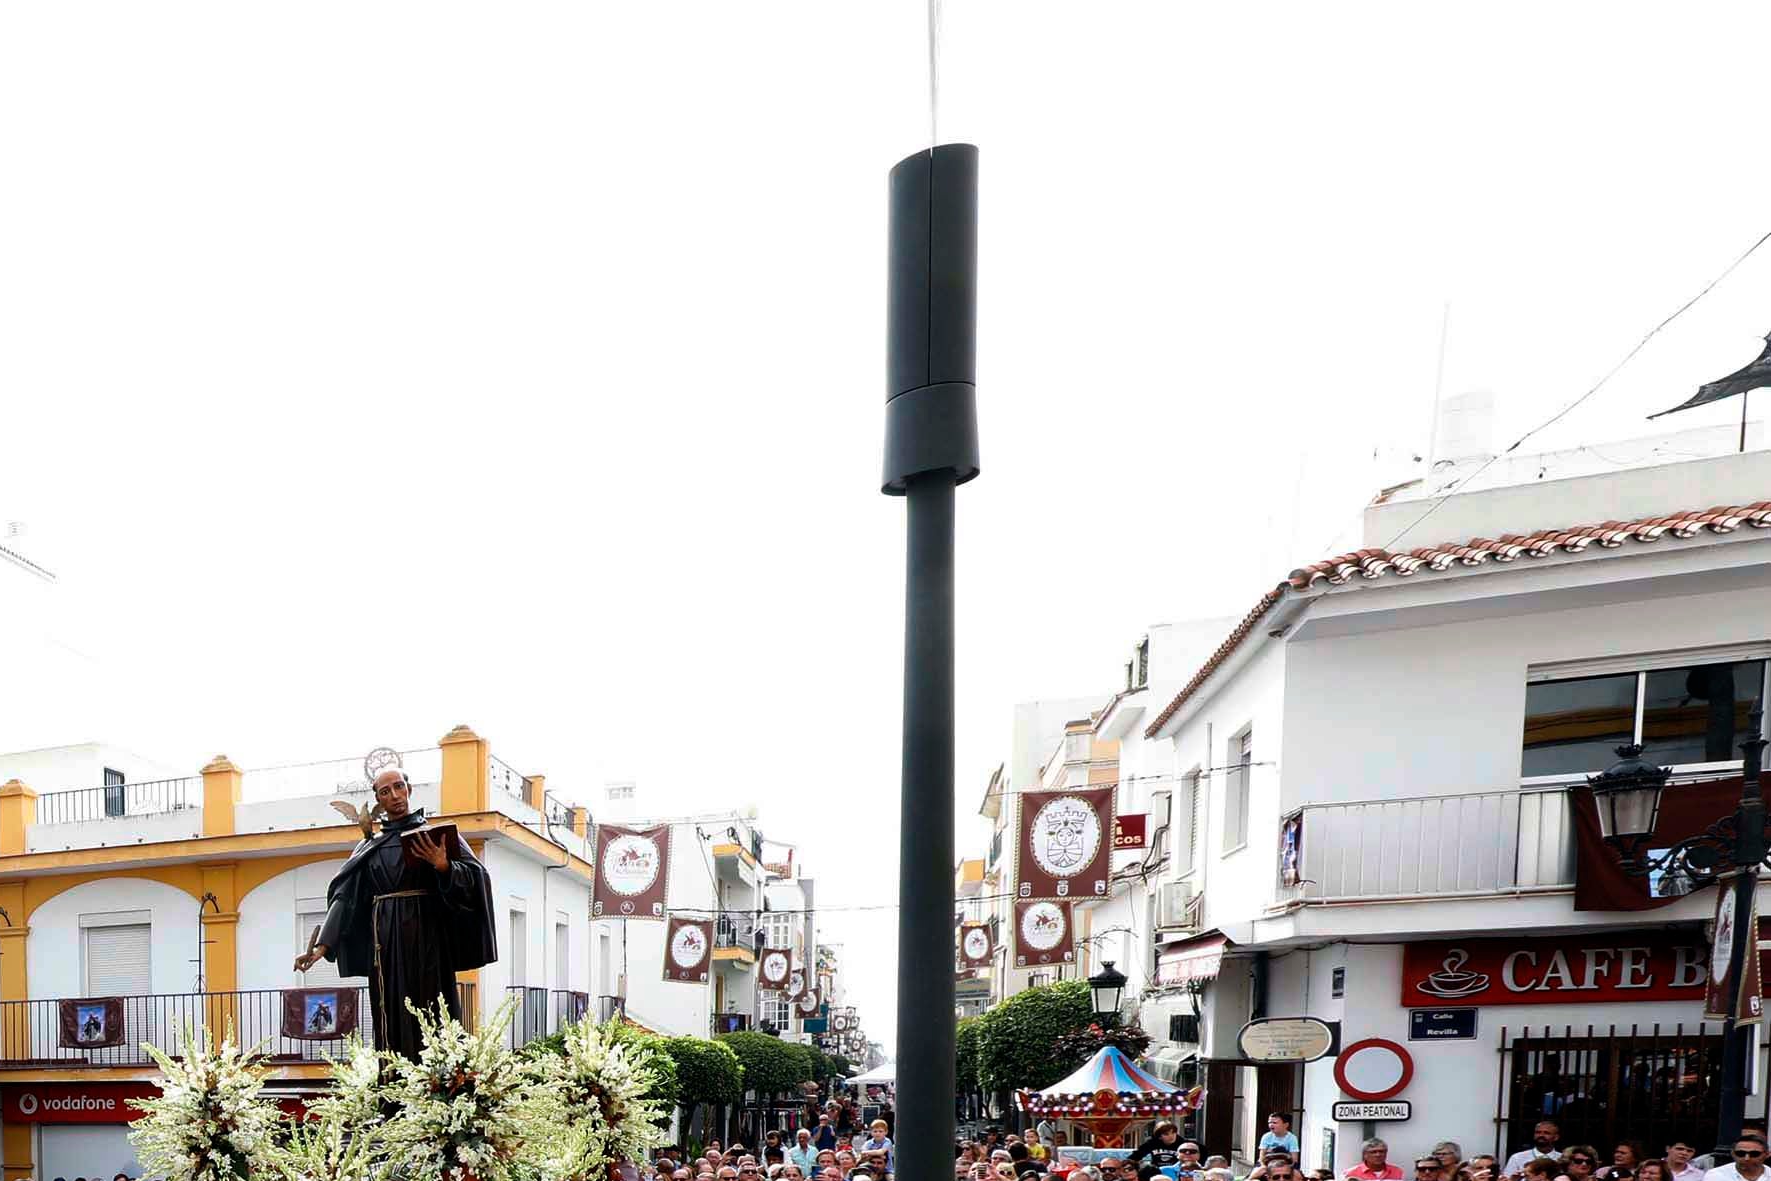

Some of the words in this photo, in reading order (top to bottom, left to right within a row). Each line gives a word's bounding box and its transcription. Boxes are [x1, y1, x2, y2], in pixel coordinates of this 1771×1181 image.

[1115, 835, 1142, 845] COS
[1501, 947, 1653, 992] CAFE
[1668, 946, 1708, 987] B
[43, 1096, 116, 1110] vodafone
[1338, 1106, 1361, 1117] ZONA
[1363, 1105, 1407, 1117] PEATONAL
